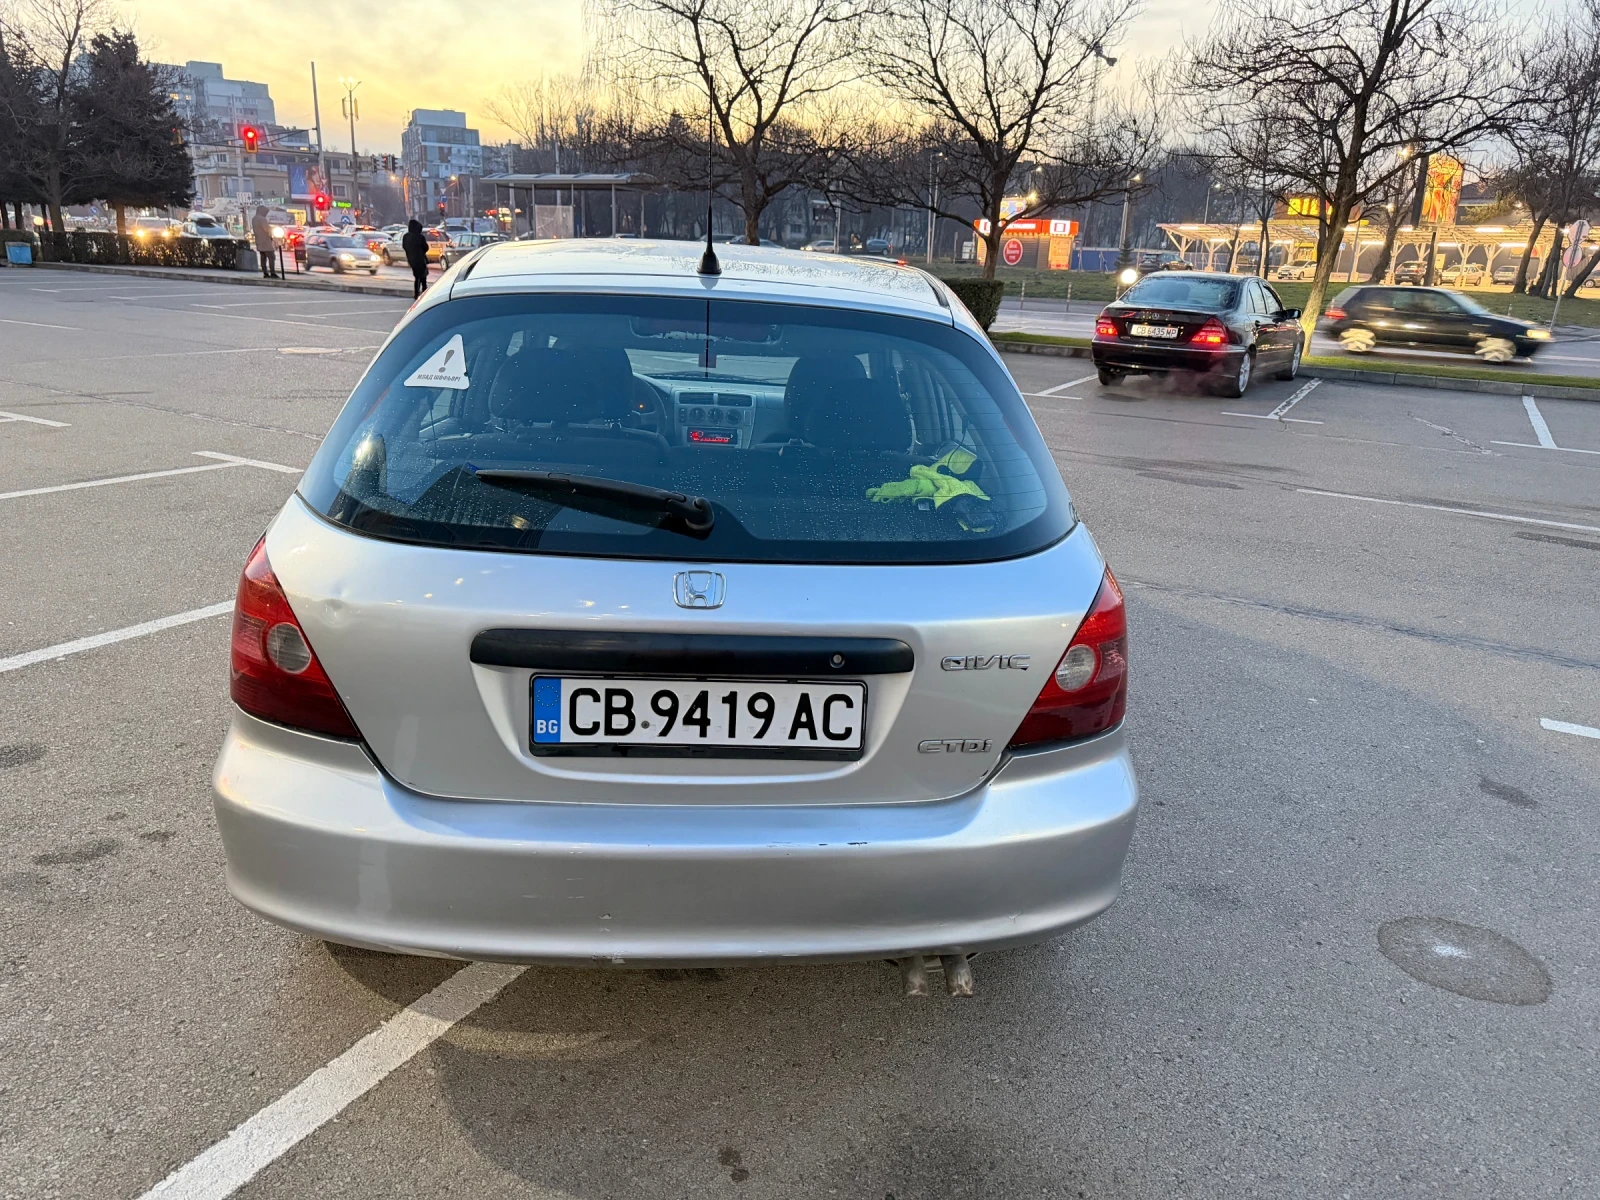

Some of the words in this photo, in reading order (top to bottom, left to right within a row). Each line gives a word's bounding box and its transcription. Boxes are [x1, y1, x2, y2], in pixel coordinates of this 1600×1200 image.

[1147, 328, 1165, 336] 6435
[941, 655, 1030, 671] CIVIC
[569, 687, 636, 736] CB
[650, 689, 776, 739] 9419
[787, 692, 854, 741] AC
[536, 719, 558, 734] BG
[917, 739, 993, 753] CTDi
